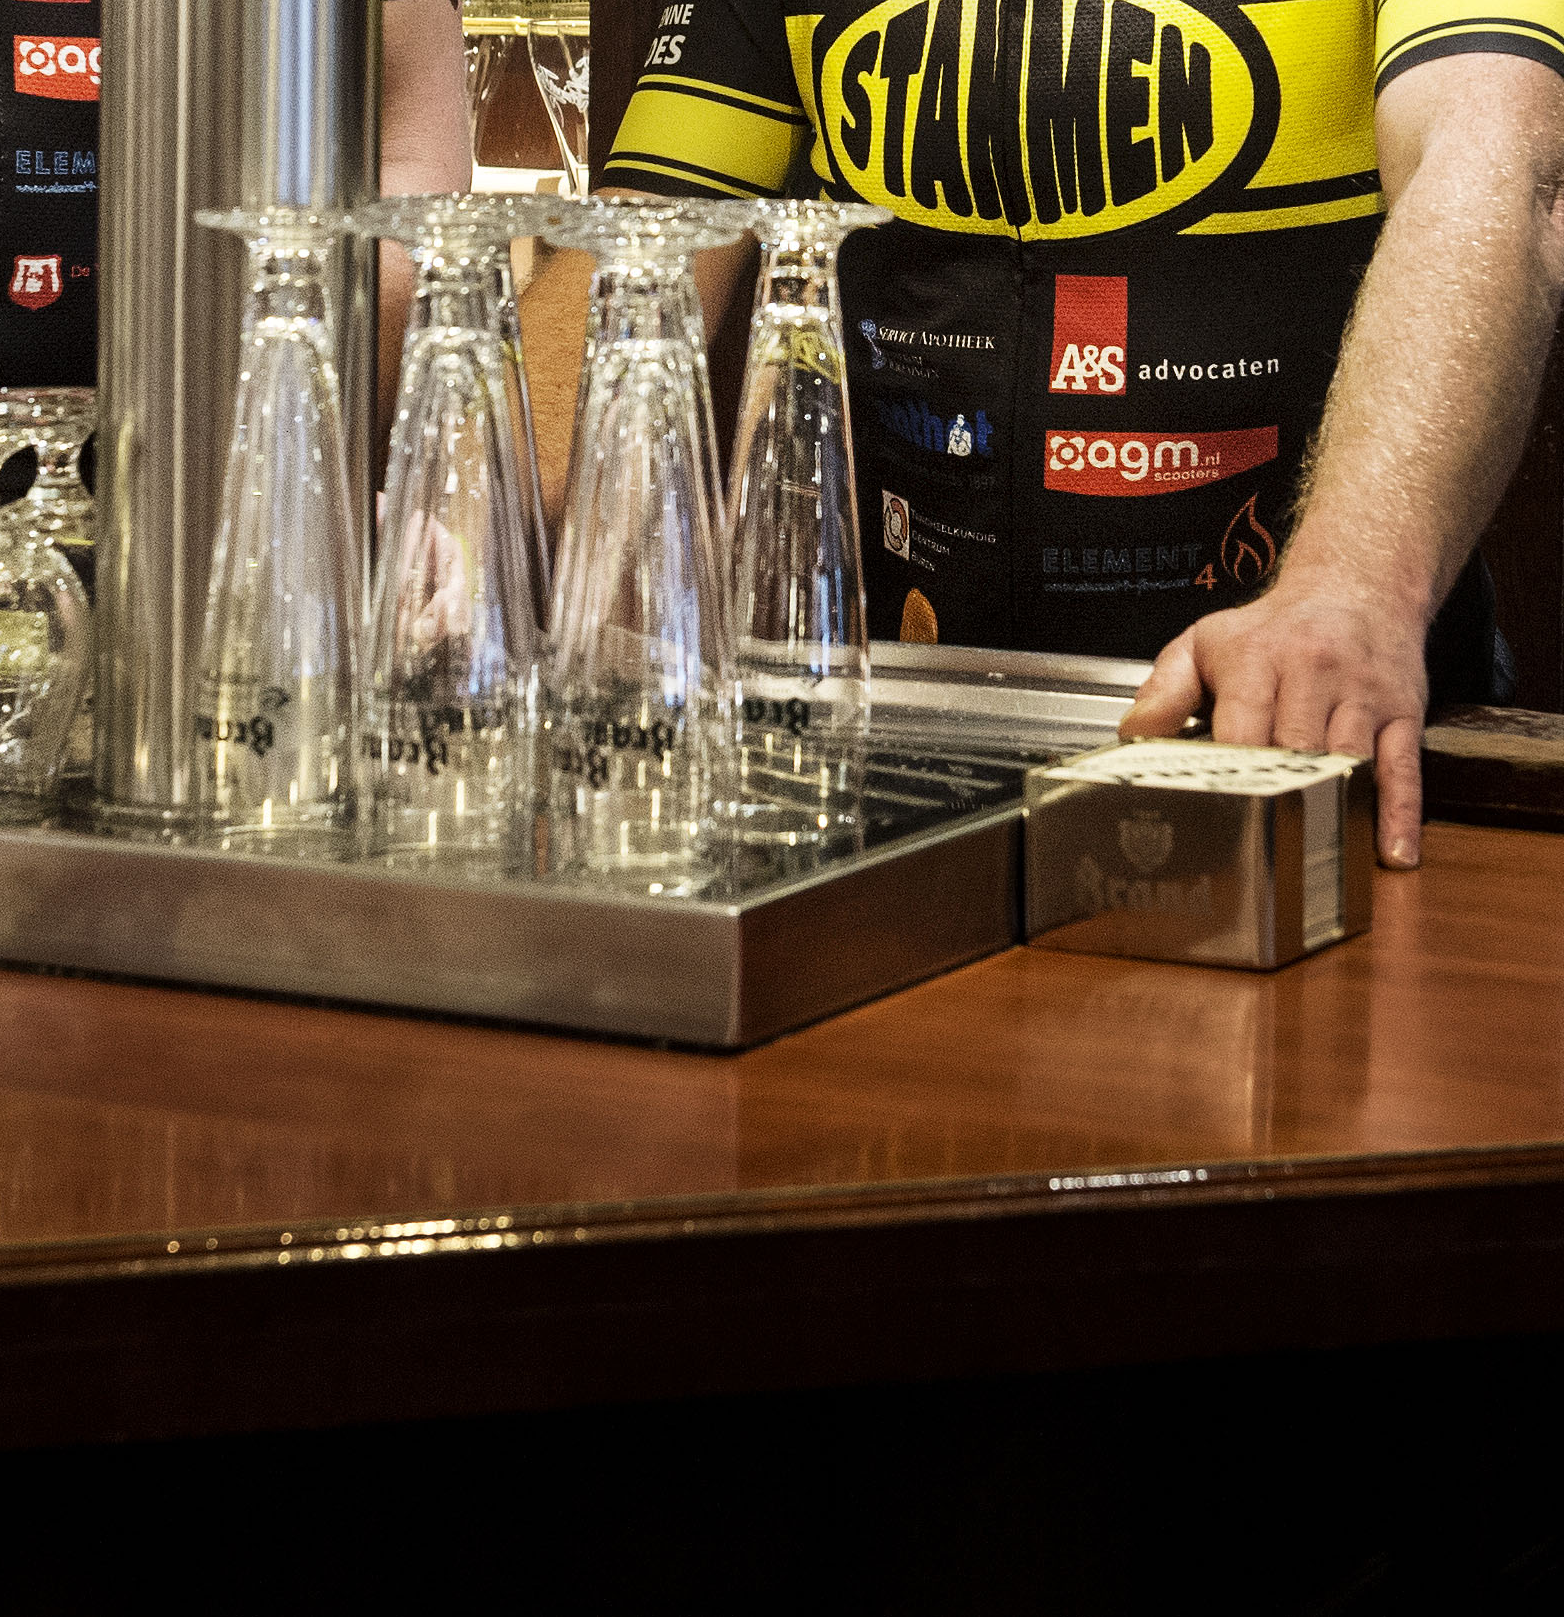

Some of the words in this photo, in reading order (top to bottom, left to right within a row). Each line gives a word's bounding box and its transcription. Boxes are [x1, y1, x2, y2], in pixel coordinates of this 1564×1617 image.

[15, 150, 96, 175] ELEM
[918, 331, 998, 350] APOTHEEK
[1051, 343, 1126, 392] A&S
[1138, 356, 1281, 382] advocaten
[1154, 468, 1220, 482] scooters
[1043, 545, 1203, 574] ELEMENT
[1194, 562, 1218, 591] 4
